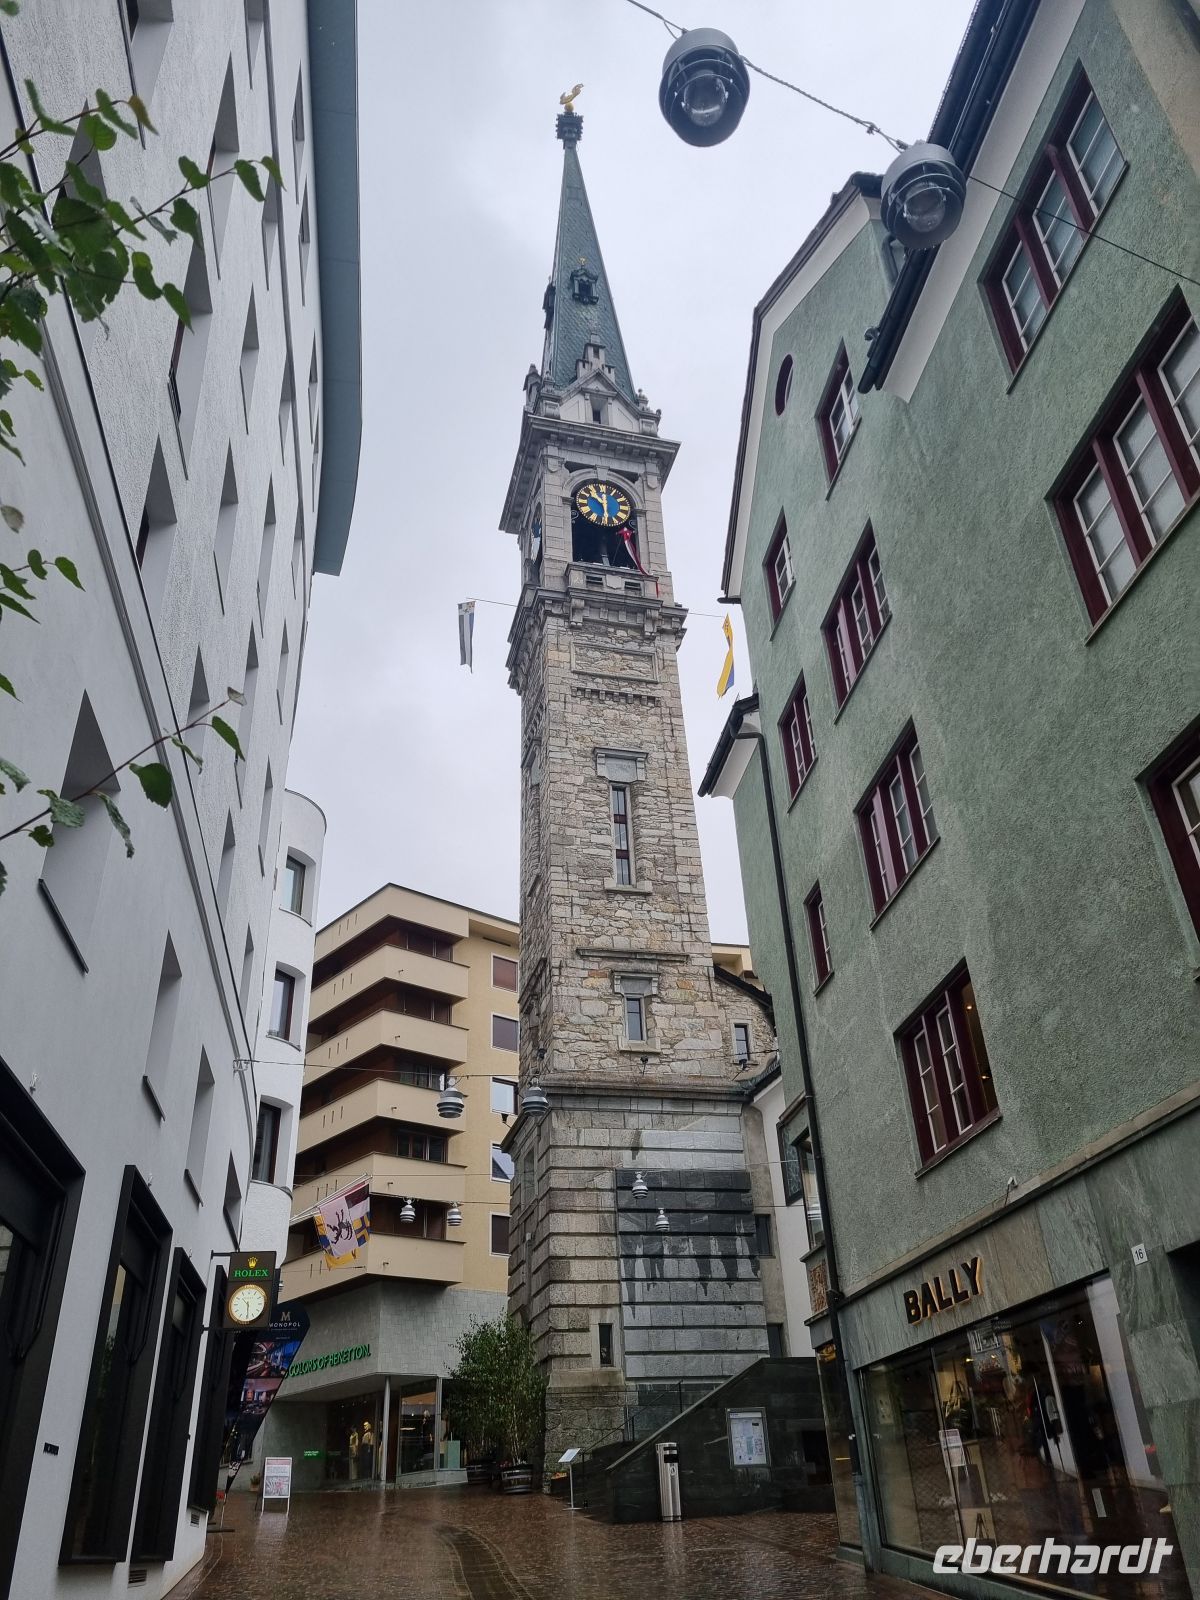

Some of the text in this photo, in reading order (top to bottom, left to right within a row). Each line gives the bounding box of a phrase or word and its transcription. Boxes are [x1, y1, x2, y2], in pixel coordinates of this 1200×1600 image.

[1135, 1248, 1144, 1260] 16
[234, 1269, 269, 1278] ROLEX
[903, 1256, 984, 1326] BALLY
[289, 1358, 318, 1377] COLORS
